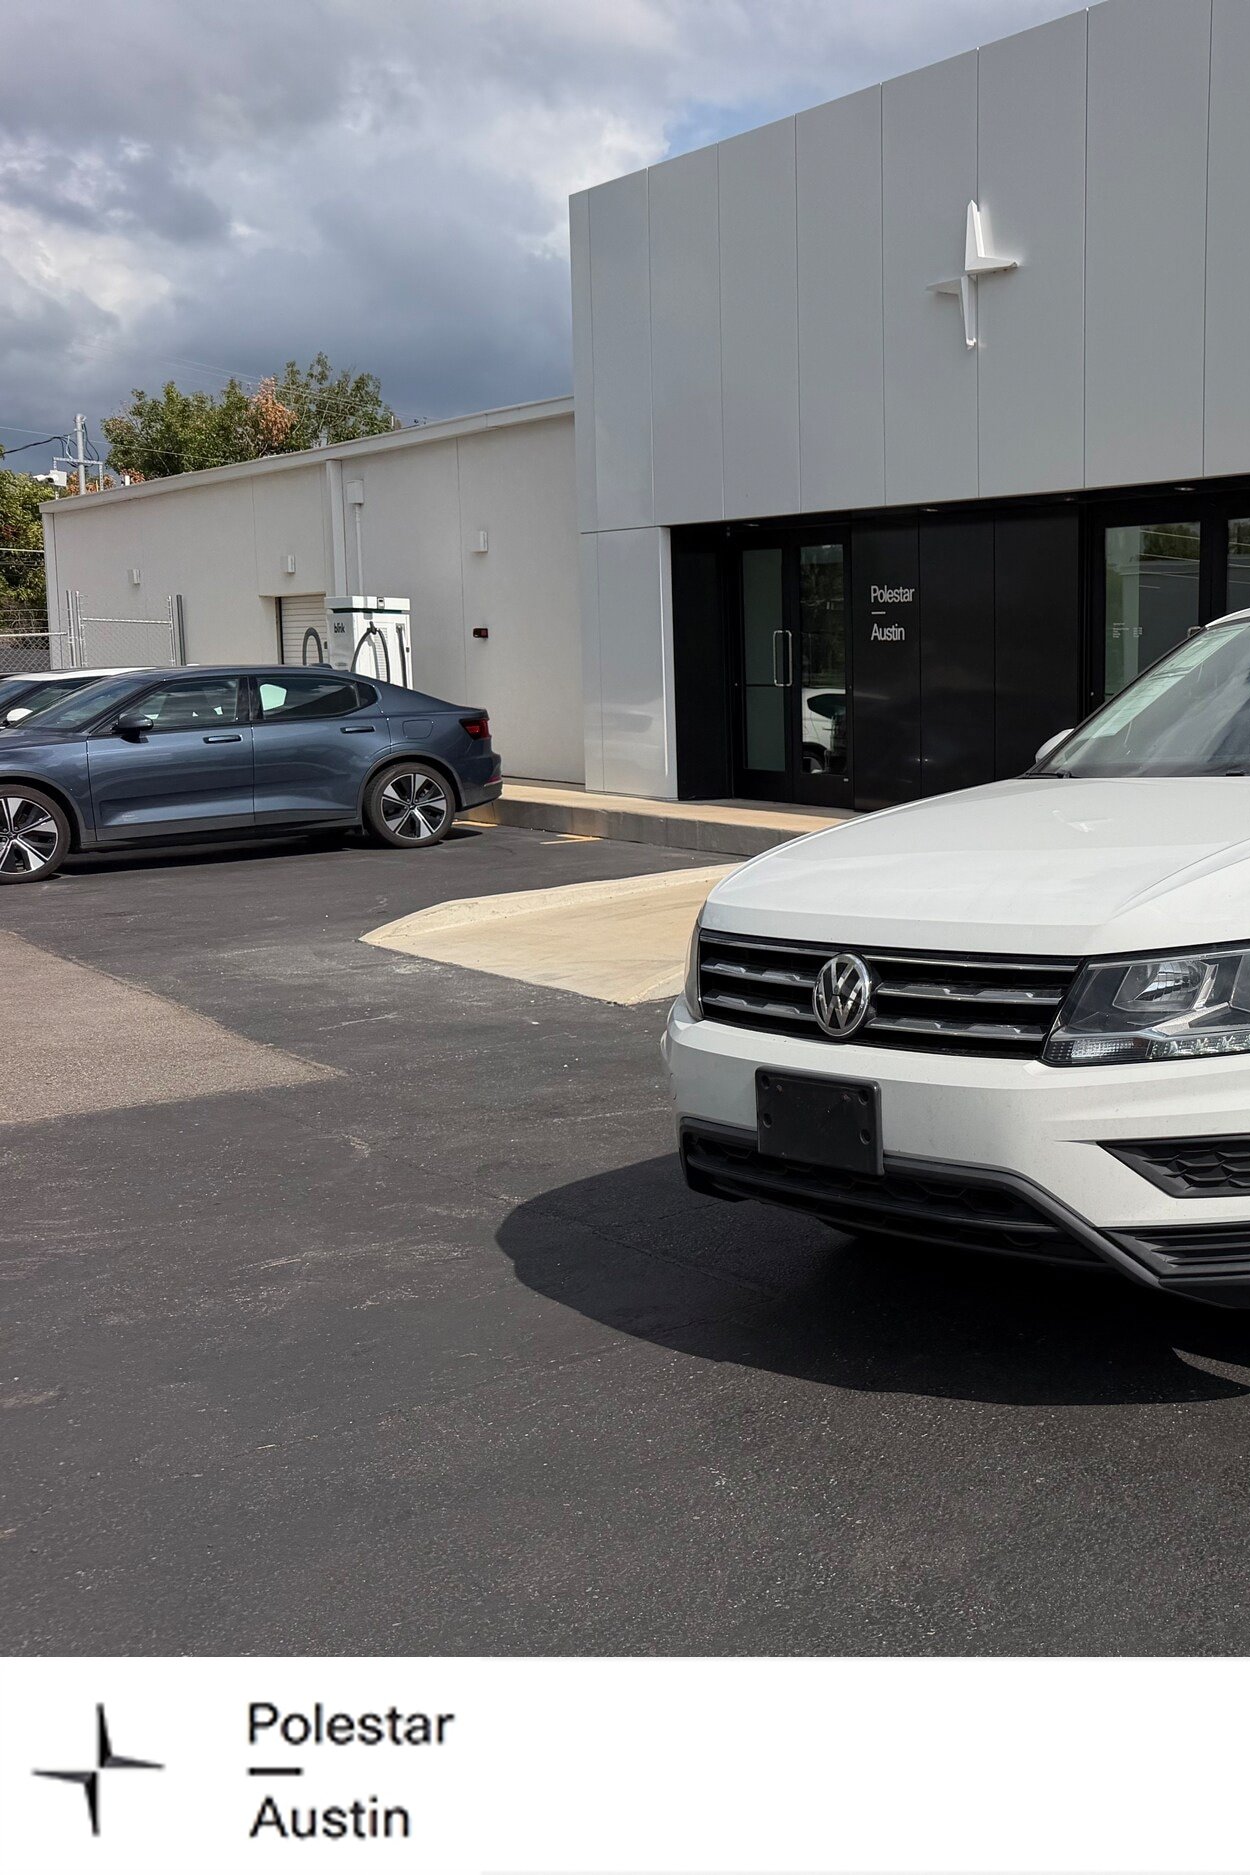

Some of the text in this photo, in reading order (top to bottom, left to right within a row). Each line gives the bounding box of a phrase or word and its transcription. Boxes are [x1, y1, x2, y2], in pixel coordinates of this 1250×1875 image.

[870, 584, 915, 603] Polestar
[333, 622, 346, 634] blink
[870, 623, 905, 641] Austin
